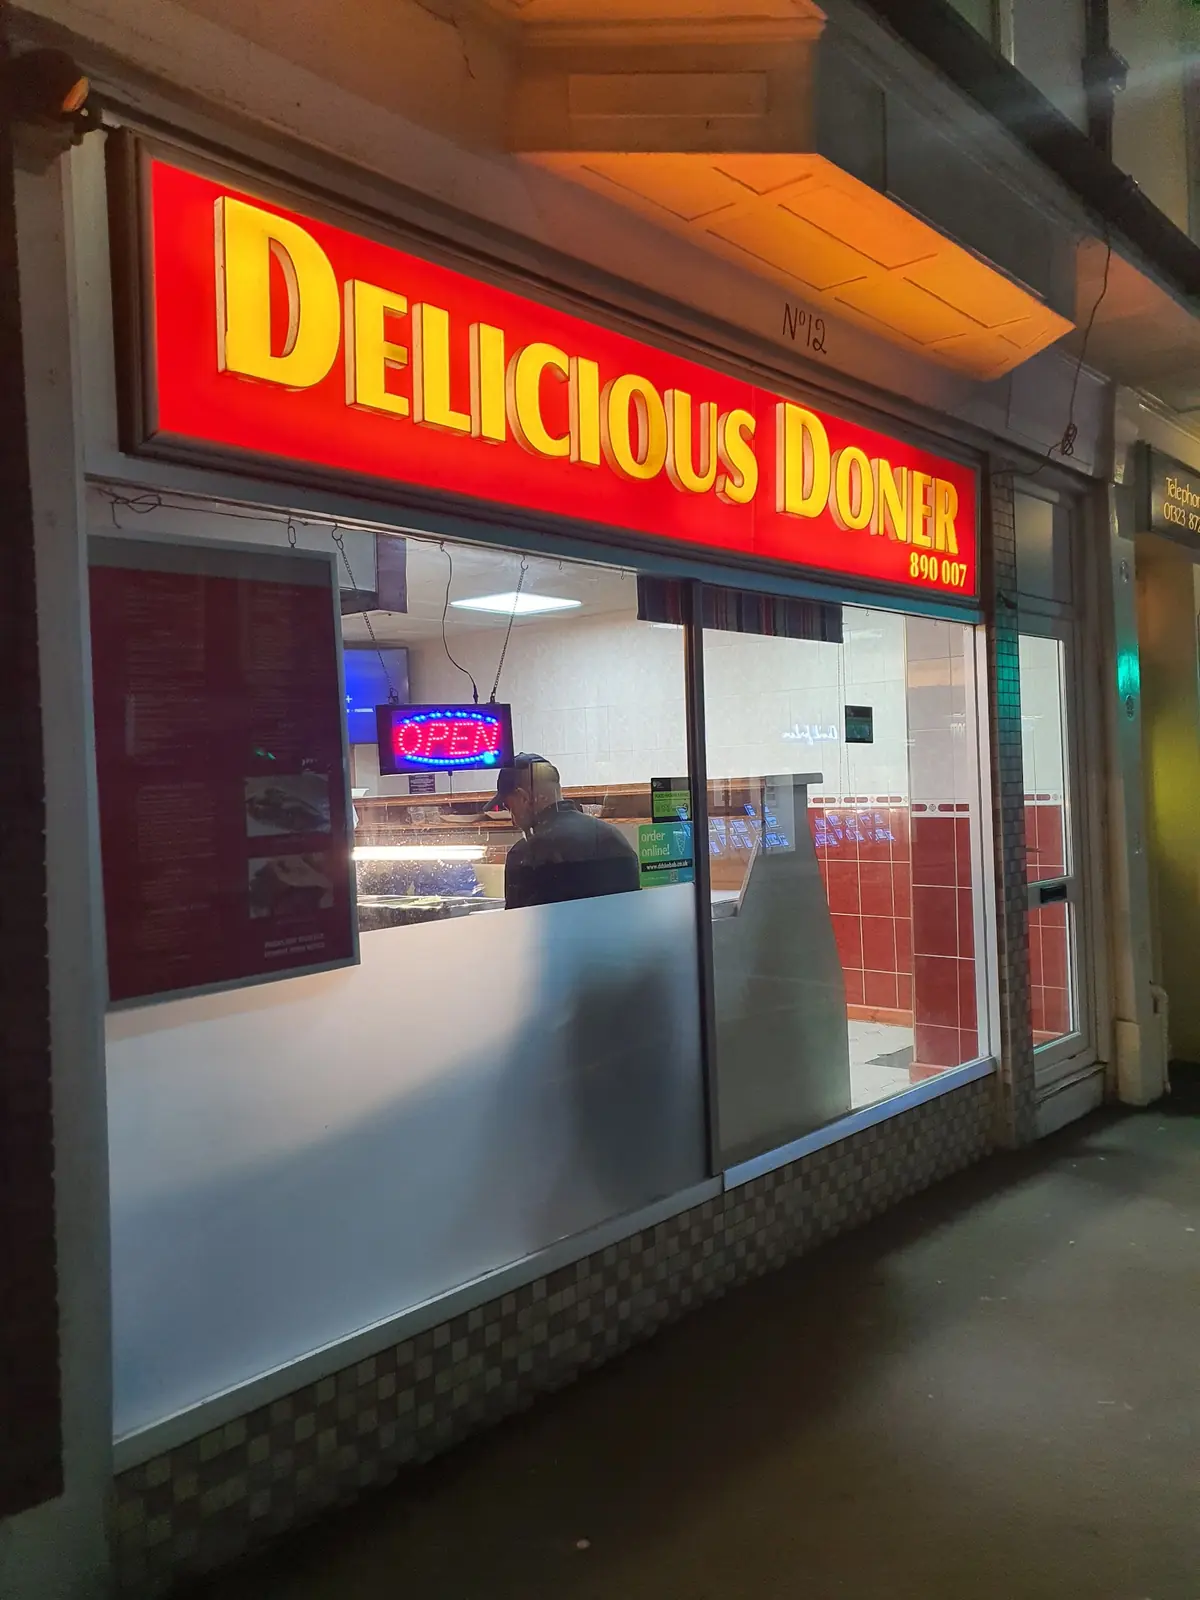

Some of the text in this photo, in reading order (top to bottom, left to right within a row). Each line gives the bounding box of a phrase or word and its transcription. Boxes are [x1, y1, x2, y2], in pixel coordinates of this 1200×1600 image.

[214, 196, 960, 555] DELICIOUS DONER
[1164, 502, 1186, 527] 01323
[910, 552, 968, 588] 890 007
[398, 721, 499, 756] OPEN
[641, 829, 666, 842] order
[642, 843, 670, 857] online!
